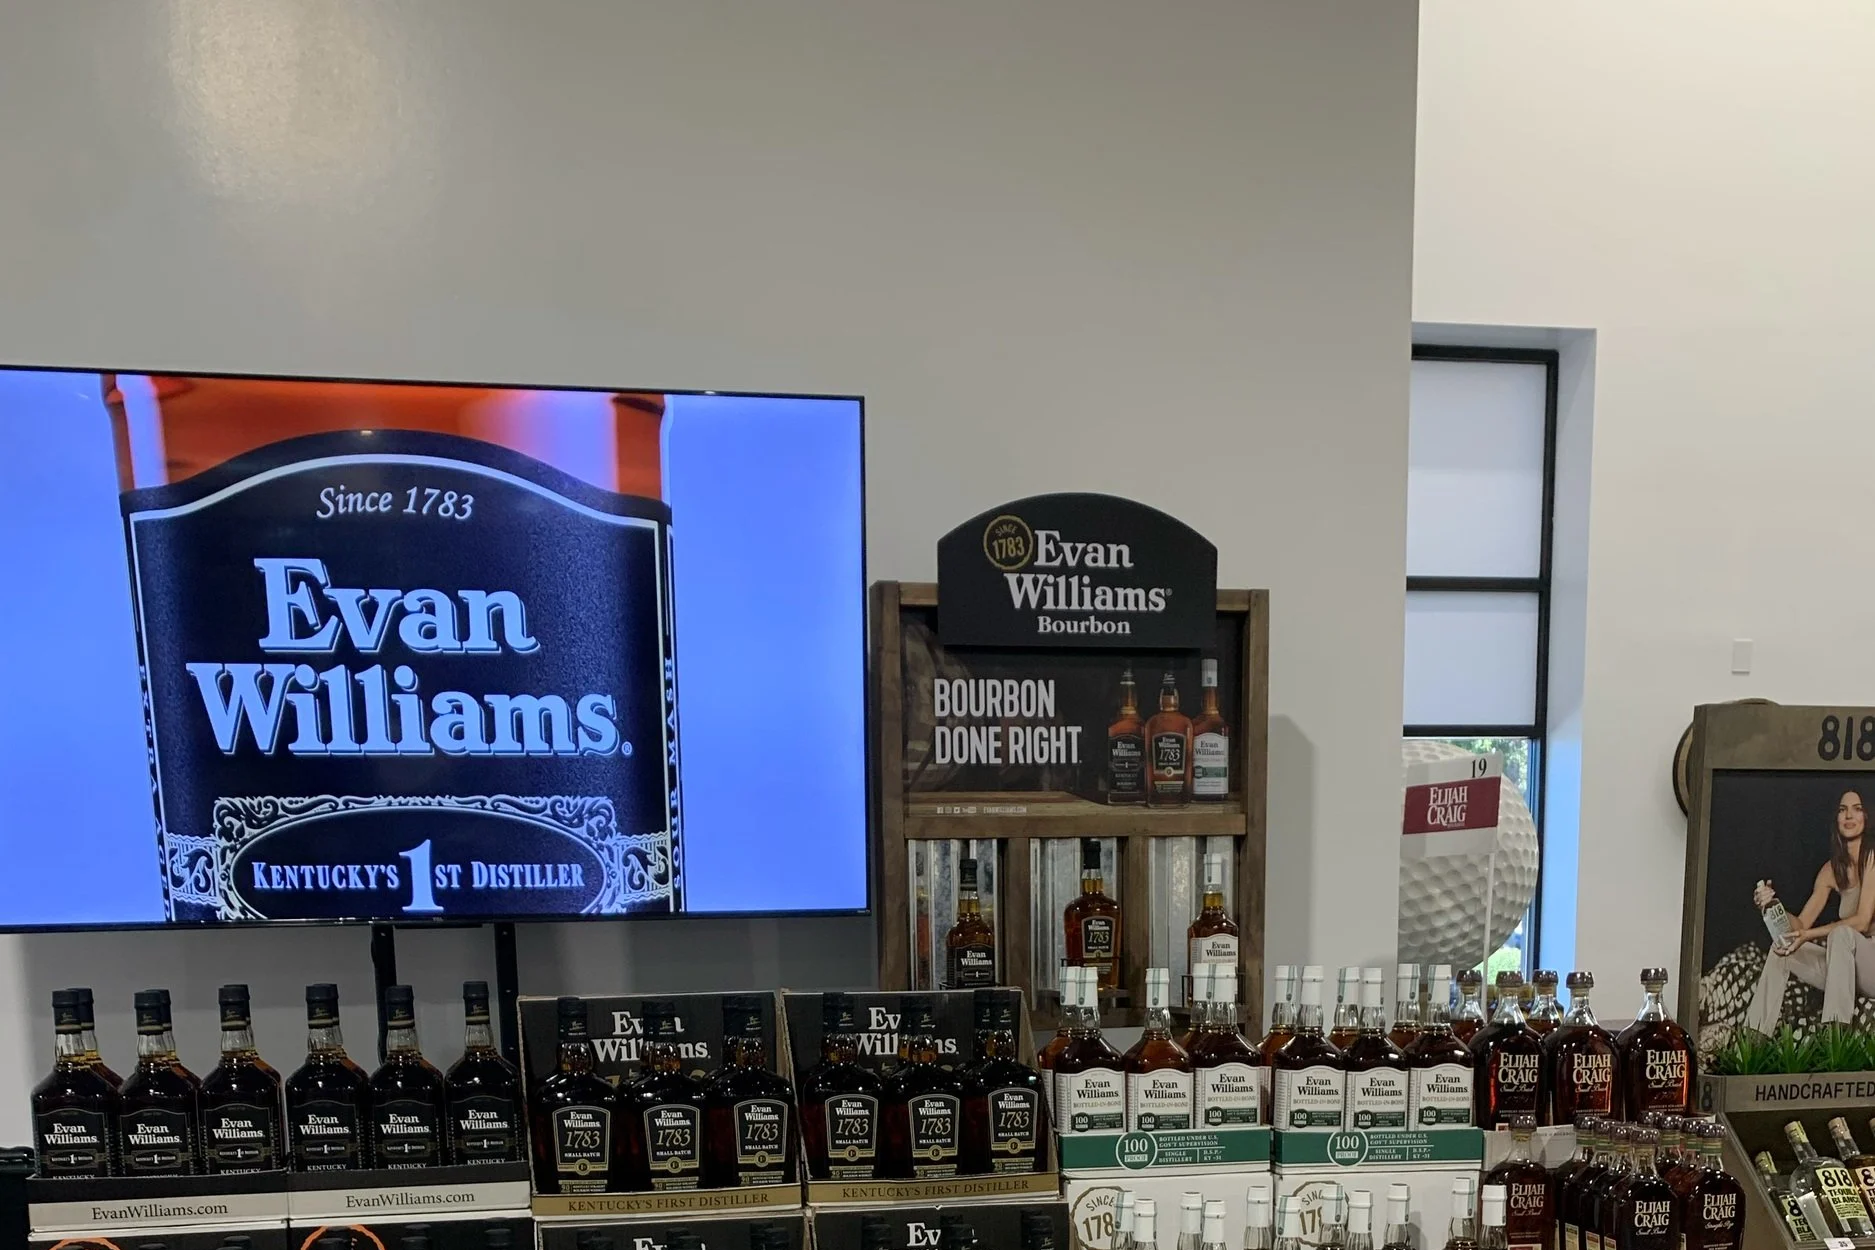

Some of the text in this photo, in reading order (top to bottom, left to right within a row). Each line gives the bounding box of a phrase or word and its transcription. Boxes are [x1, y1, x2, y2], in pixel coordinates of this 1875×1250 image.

[315, 485, 475, 522] Since 1783
[995, 523, 1018, 536] SINCE
[992, 536, 1024, 560] 1783
[1034, 529, 1134, 568] Evan
[253, 557, 540, 654] Evan
[1037, 615, 1131, 634] Bourbon
[934, 678, 1056, 718] BOURBON
[934, 726, 1002, 764] DONE
[1470, 758, 1487, 779] 19
[1428, 786, 1469, 806] ELIJAH
[1427, 804, 1467, 827] CRAIG
[252, 860, 400, 891] KENTUCKY'S
[470, 860, 585, 891] DISTILLER
[1646, 1049, 1686, 1066] ELIJAH
[1646, 1064, 1686, 1081] CRAIG
[1077, 1089, 1119, 1098] Williams
[1084, 1079, 1111, 1089] Evan
[1756, 1081, 1875, 1101] HANDCRAFTED
[466, 1110, 499, 1121] Evan
[570, 1112, 593, 1120] Evan
[53, 1123, 86, 1133] Evan
[564, 1129, 600, 1149] 1783
[1124, 1138, 1148, 1153] 100
[345, 1191, 475, 1208] EvanWilliams.com
[568, 1194, 769, 1212] KENTUCKY'S FIRST DISTILLER
[1635, 1200, 1670, 1215] ELIJAH
[91, 1202, 228, 1221] EvanWilliams.com
[1634, 1212, 1669, 1228] CRAIG
